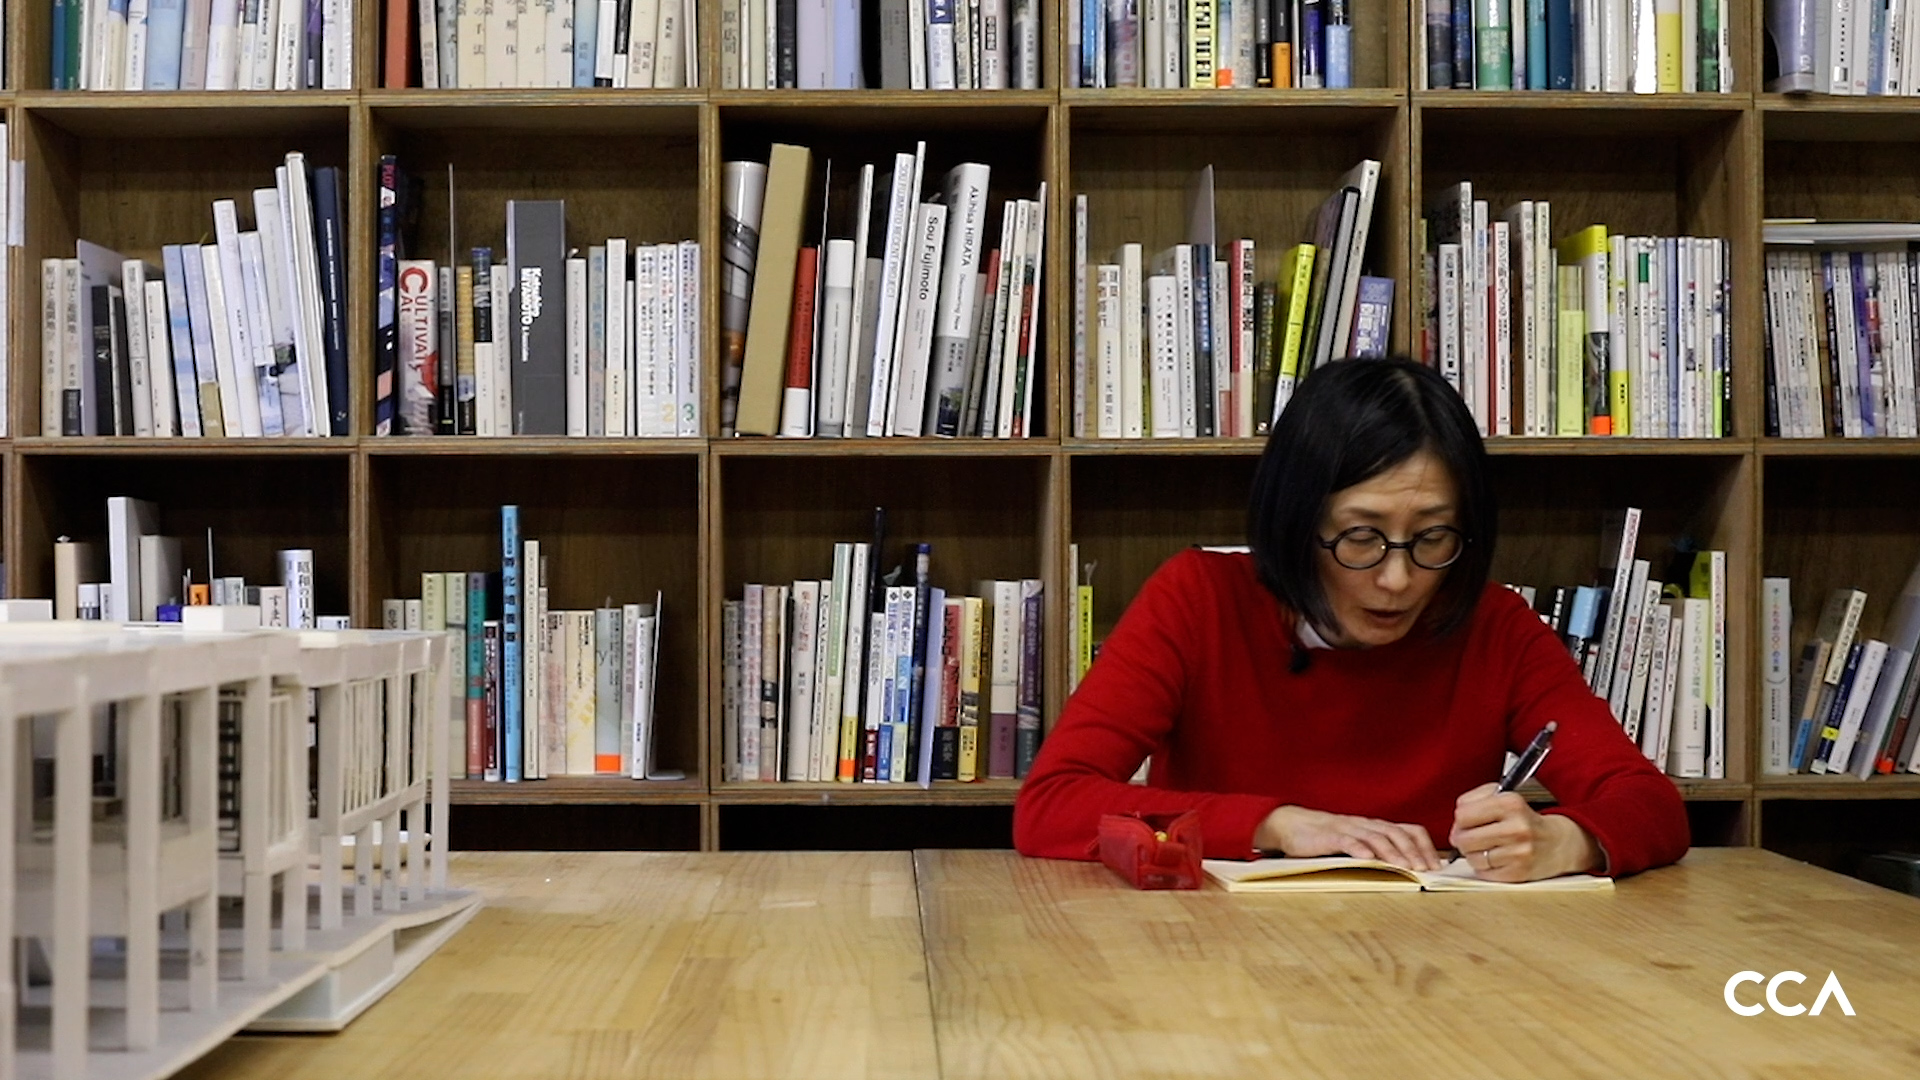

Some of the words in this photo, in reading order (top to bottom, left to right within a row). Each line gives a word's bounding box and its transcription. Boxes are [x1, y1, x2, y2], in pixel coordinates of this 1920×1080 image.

[898, 163, 910, 182] SOU
[893, 183, 907, 224] FUJIMOTO
[965, 185, 980, 225] Akihisa
[890, 225, 903, 260] RECENT
[925, 216, 939, 241] Sou
[960, 227, 974, 268] HIRATA
[531, 267, 542, 317] Katsuhiro
[886, 260, 899, 298] PROJECT
[918, 244, 936, 301] Fujimoto
[521, 267, 532, 325] MIYAMOTO
[662, 404, 675, 423] 2
[682, 403, 695, 422] 3
